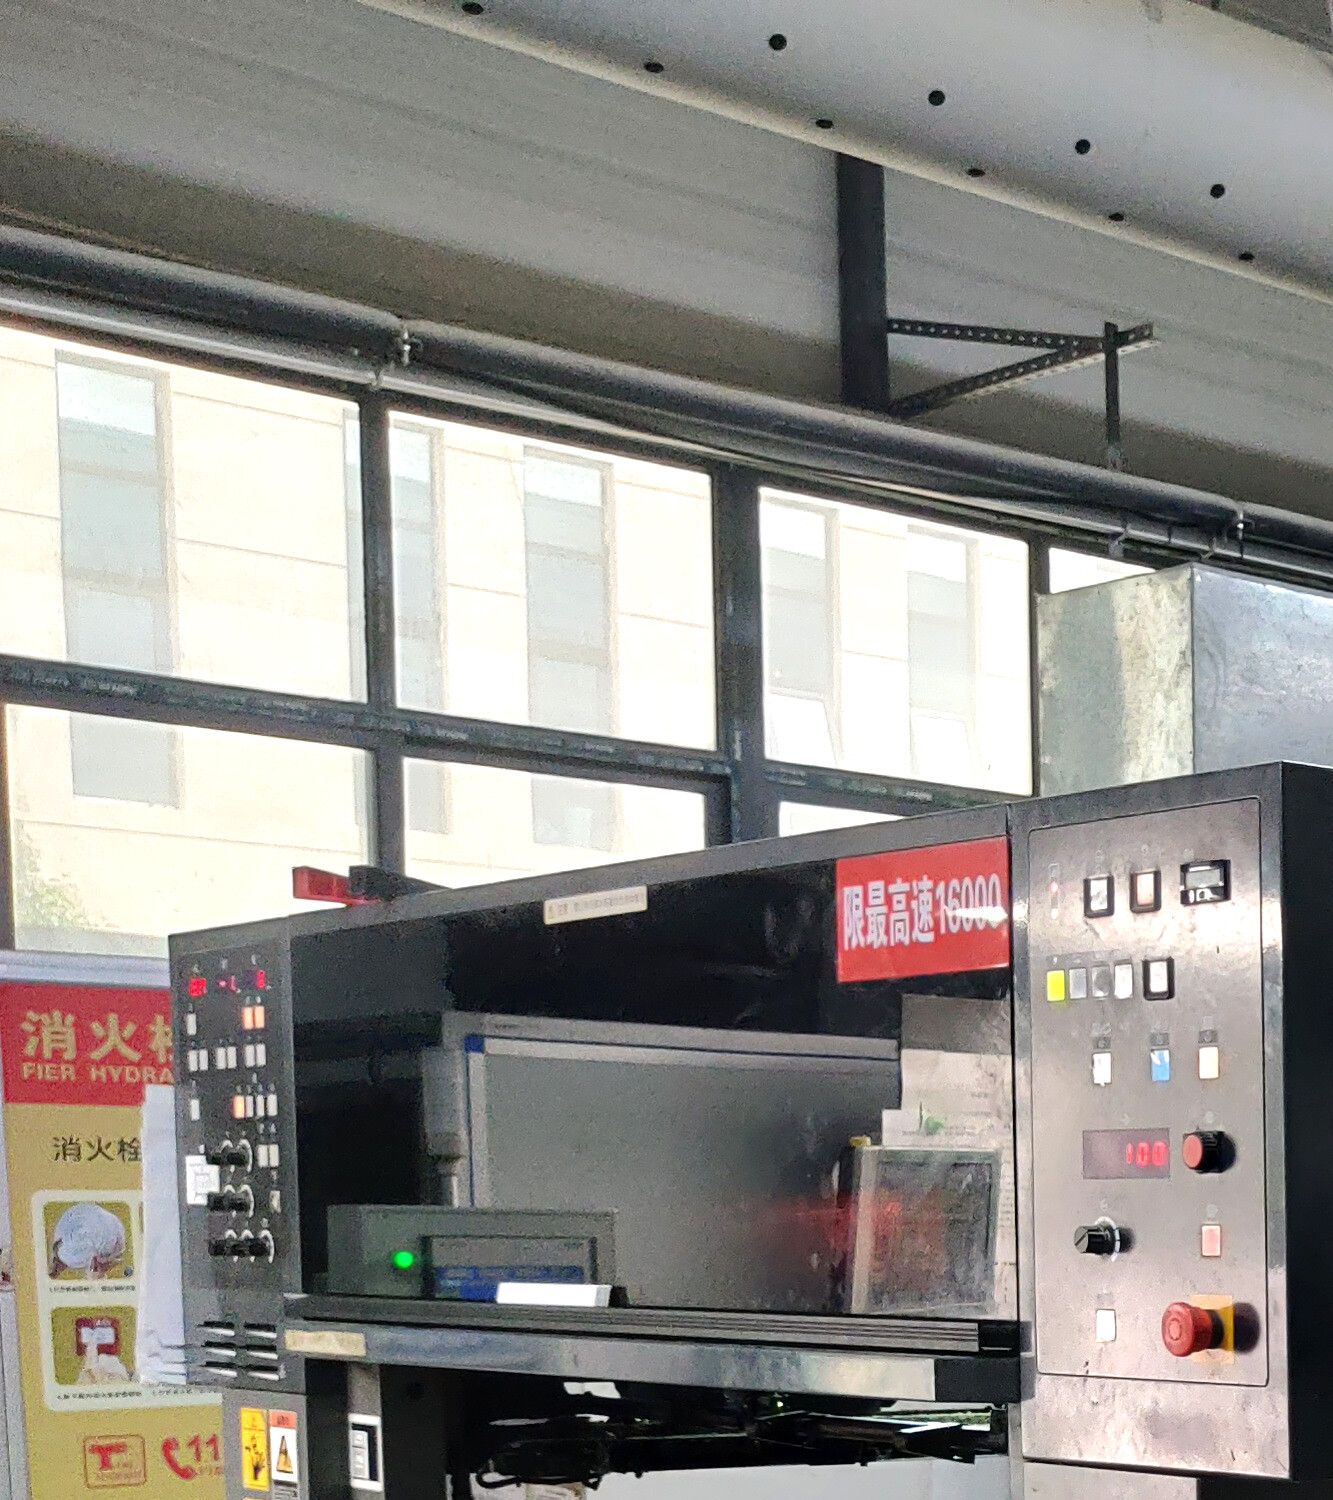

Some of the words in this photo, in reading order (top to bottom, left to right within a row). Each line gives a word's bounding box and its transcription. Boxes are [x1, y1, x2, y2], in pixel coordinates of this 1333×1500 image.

[842, 874, 1002, 950] 限最高速16000
[22, 1063, 77, 1082] FIER
